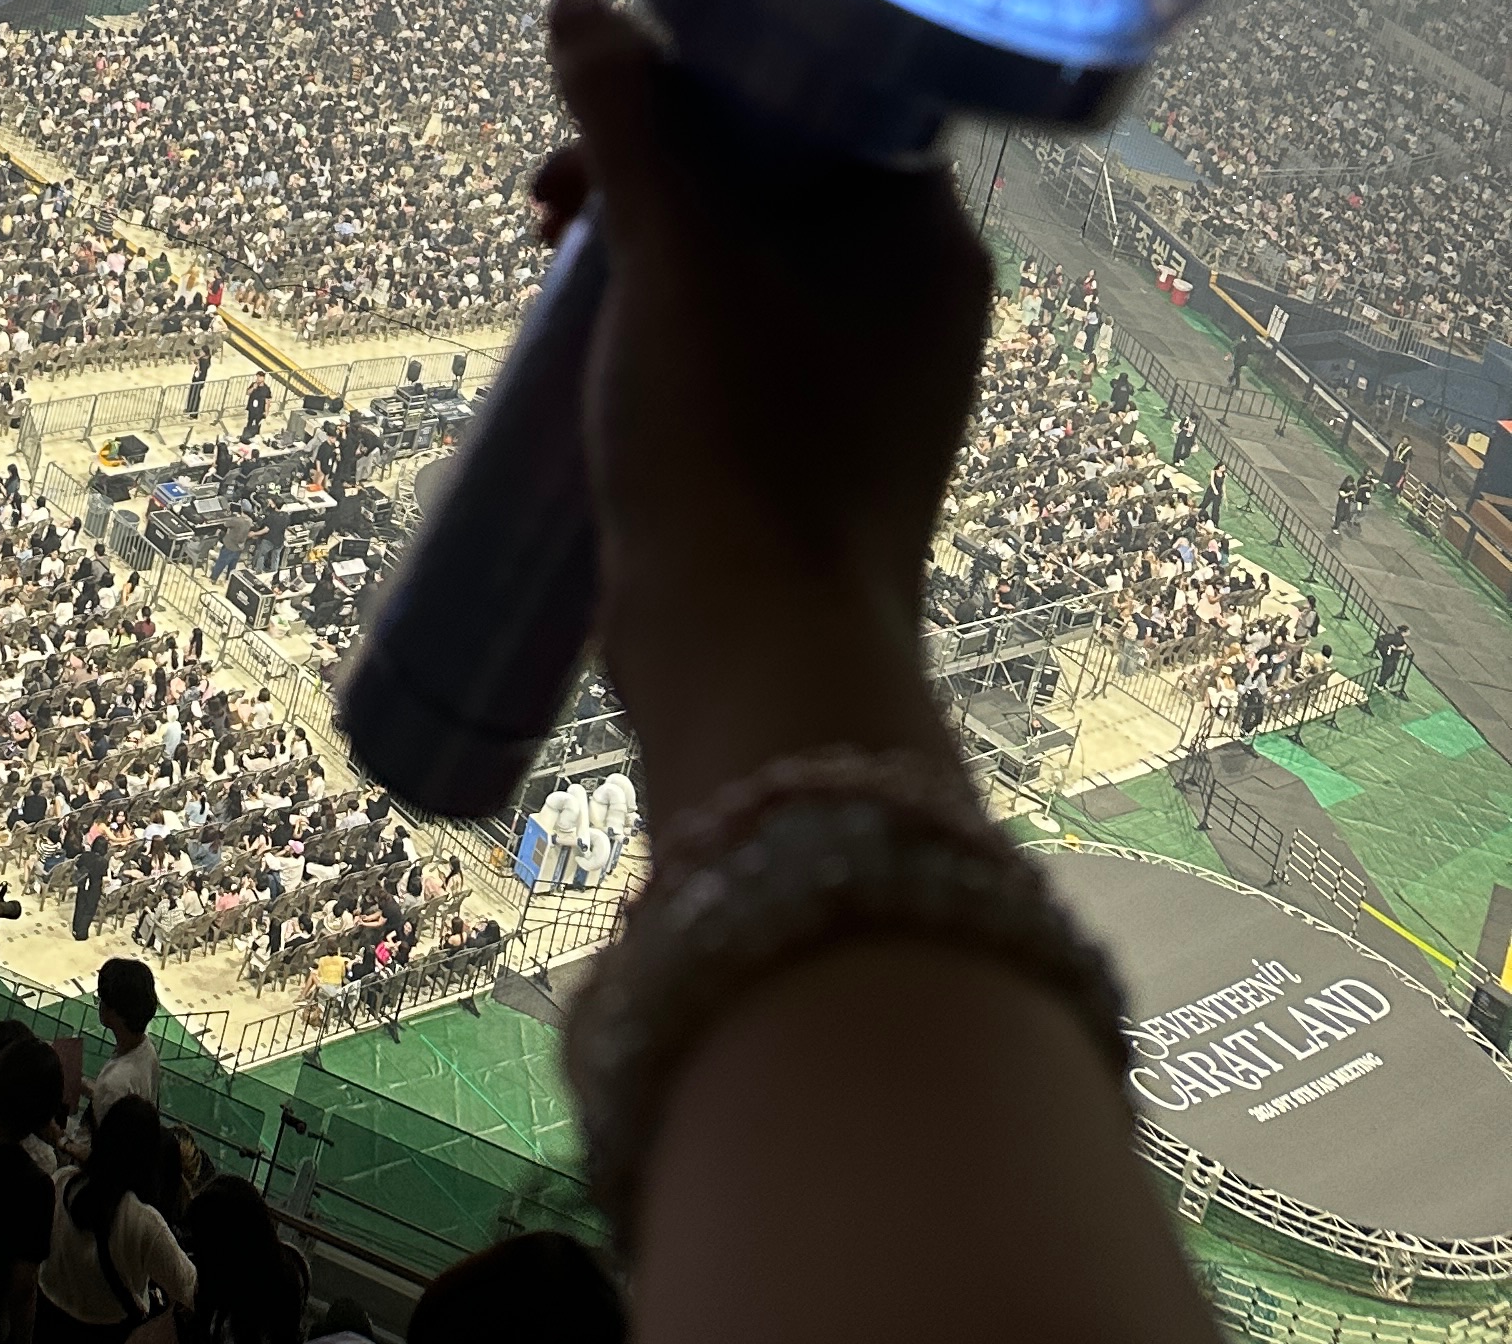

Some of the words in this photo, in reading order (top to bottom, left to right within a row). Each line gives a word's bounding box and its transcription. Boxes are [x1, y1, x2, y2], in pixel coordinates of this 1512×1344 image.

[1119, 973, 1284, 1060] SEVENTEEN
[1129, 1028, 1284, 1111] CARAT
[1257, 978, 1391, 1061] LAND
